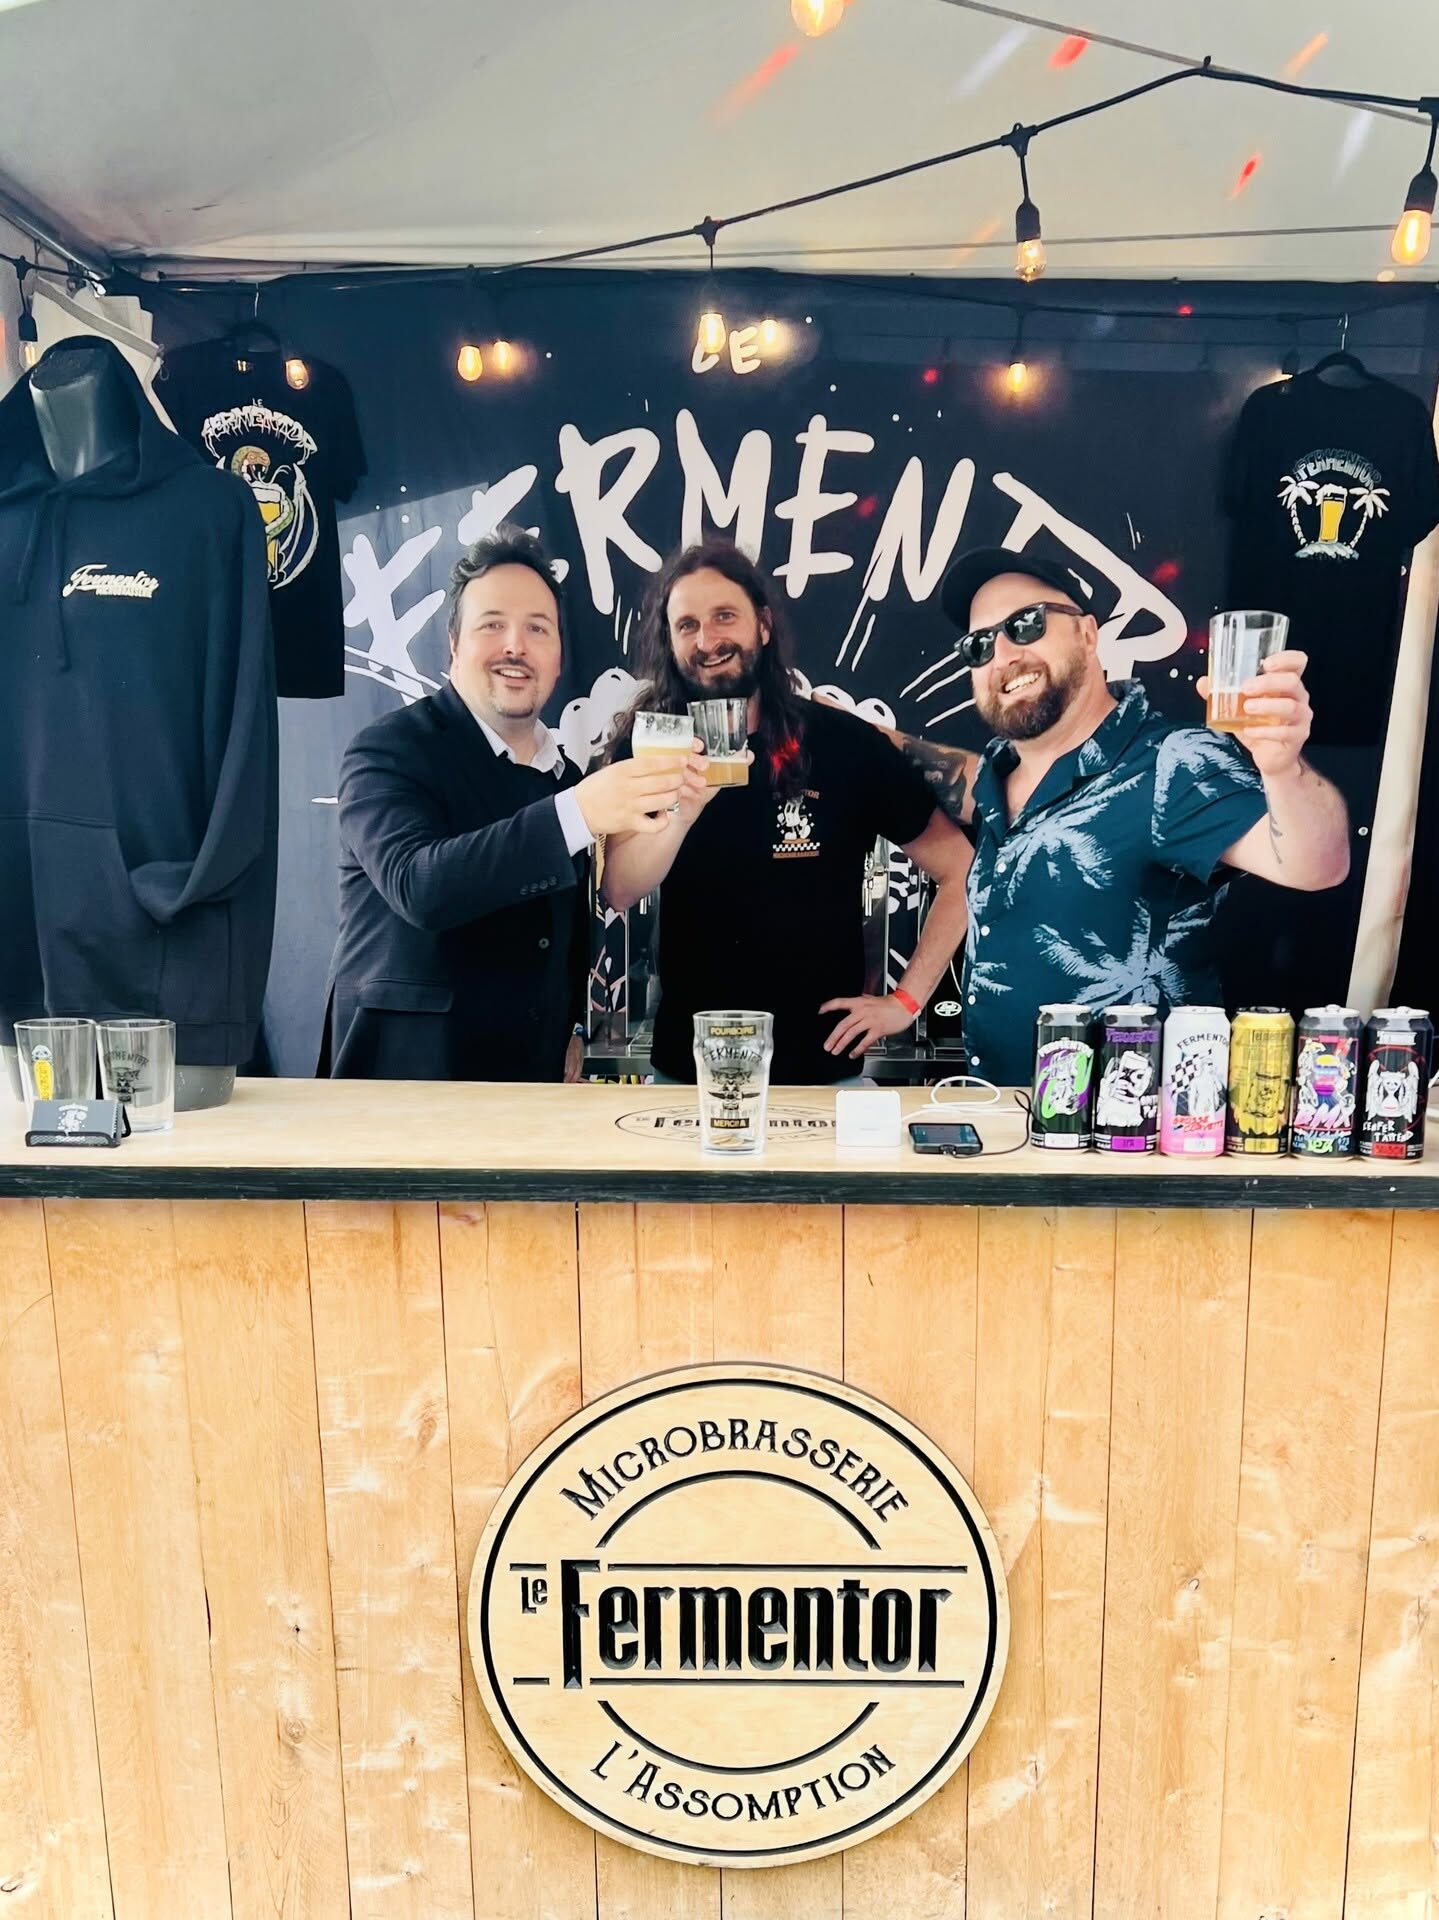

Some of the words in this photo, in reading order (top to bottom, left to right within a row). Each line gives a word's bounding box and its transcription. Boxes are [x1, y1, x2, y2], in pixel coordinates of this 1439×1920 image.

[692, 326, 761, 374] LE
[520, 1576, 548, 1614] Le
[561, 1559, 952, 1689] Fermentor
